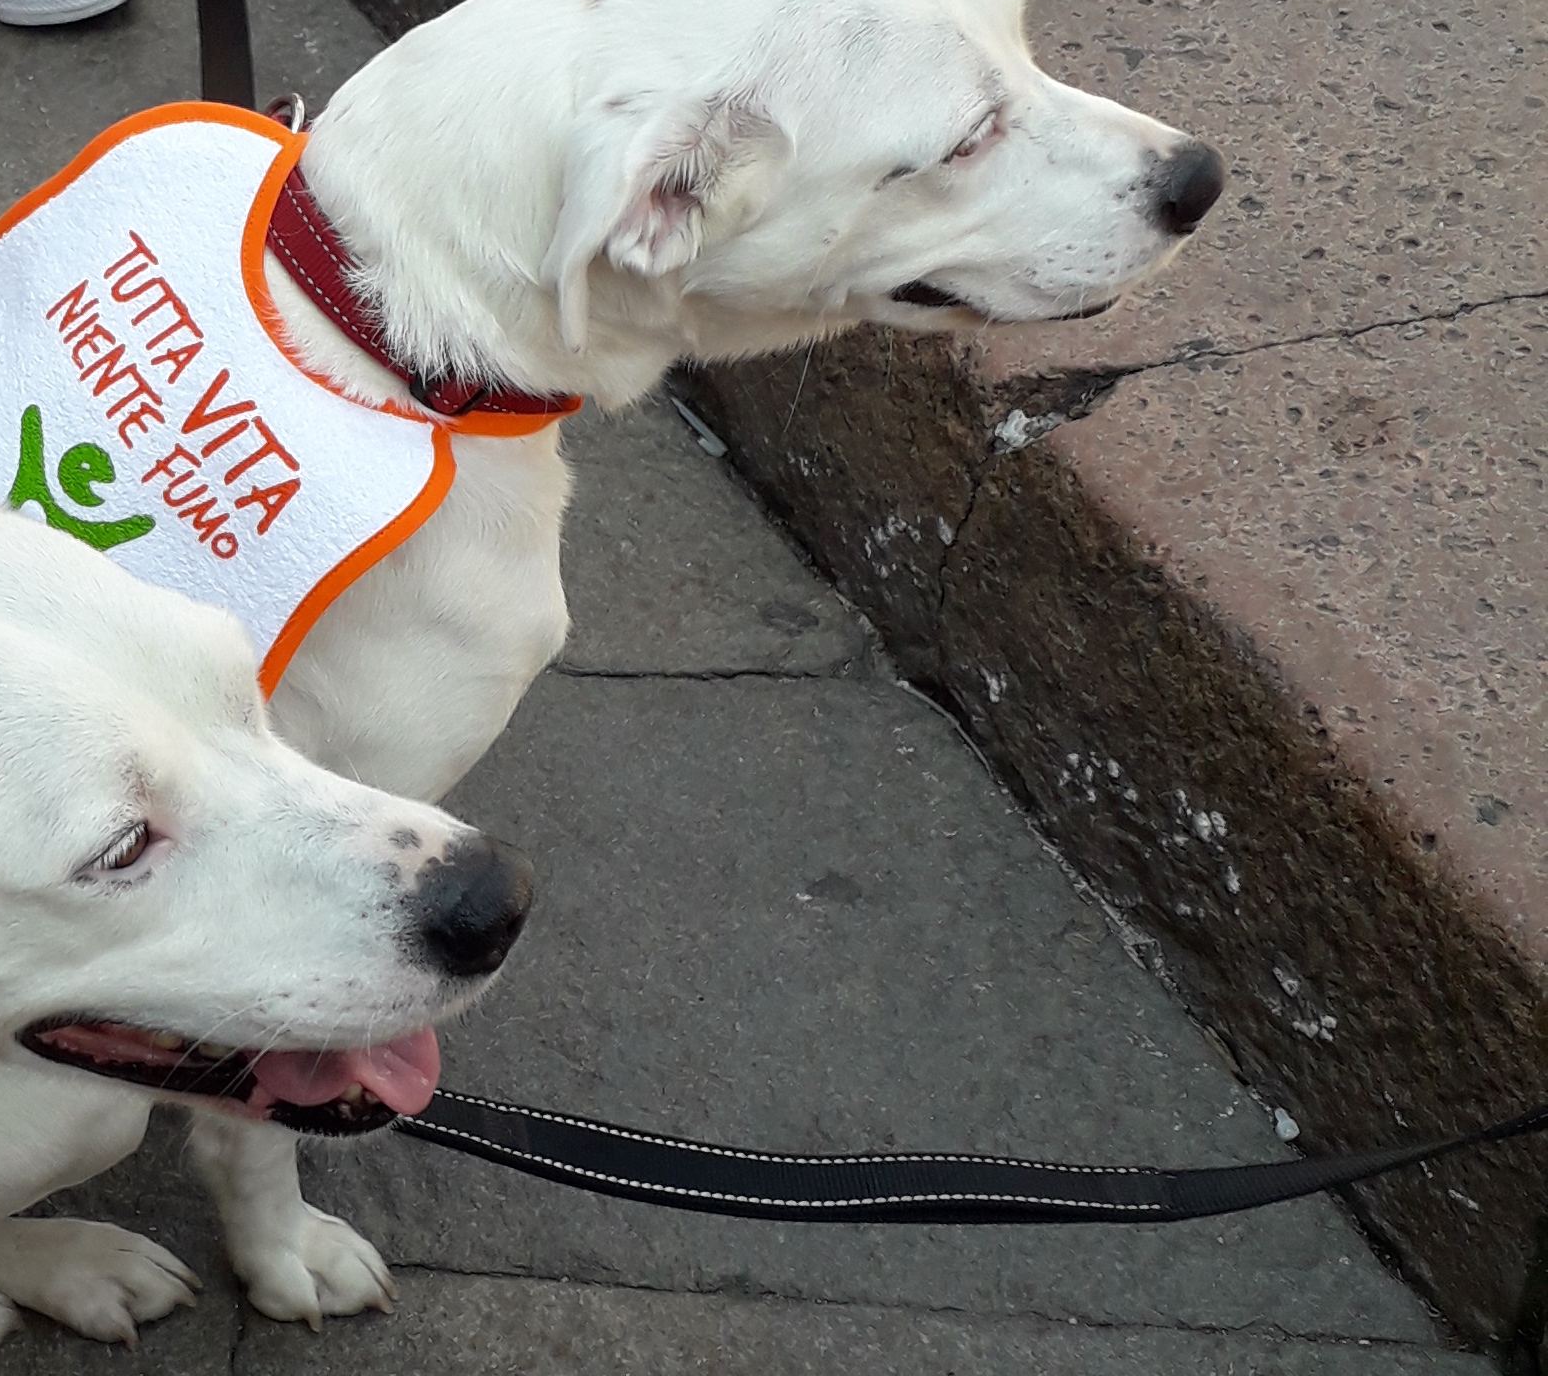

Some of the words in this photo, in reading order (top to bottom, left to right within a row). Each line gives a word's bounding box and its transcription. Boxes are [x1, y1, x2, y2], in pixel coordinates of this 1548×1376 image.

[45, 279, 166, 449] NIENTE
[141, 442, 239, 560] FUMO
[103, 229, 205, 384] TUTTA
[180, 368, 301, 536] VITA
